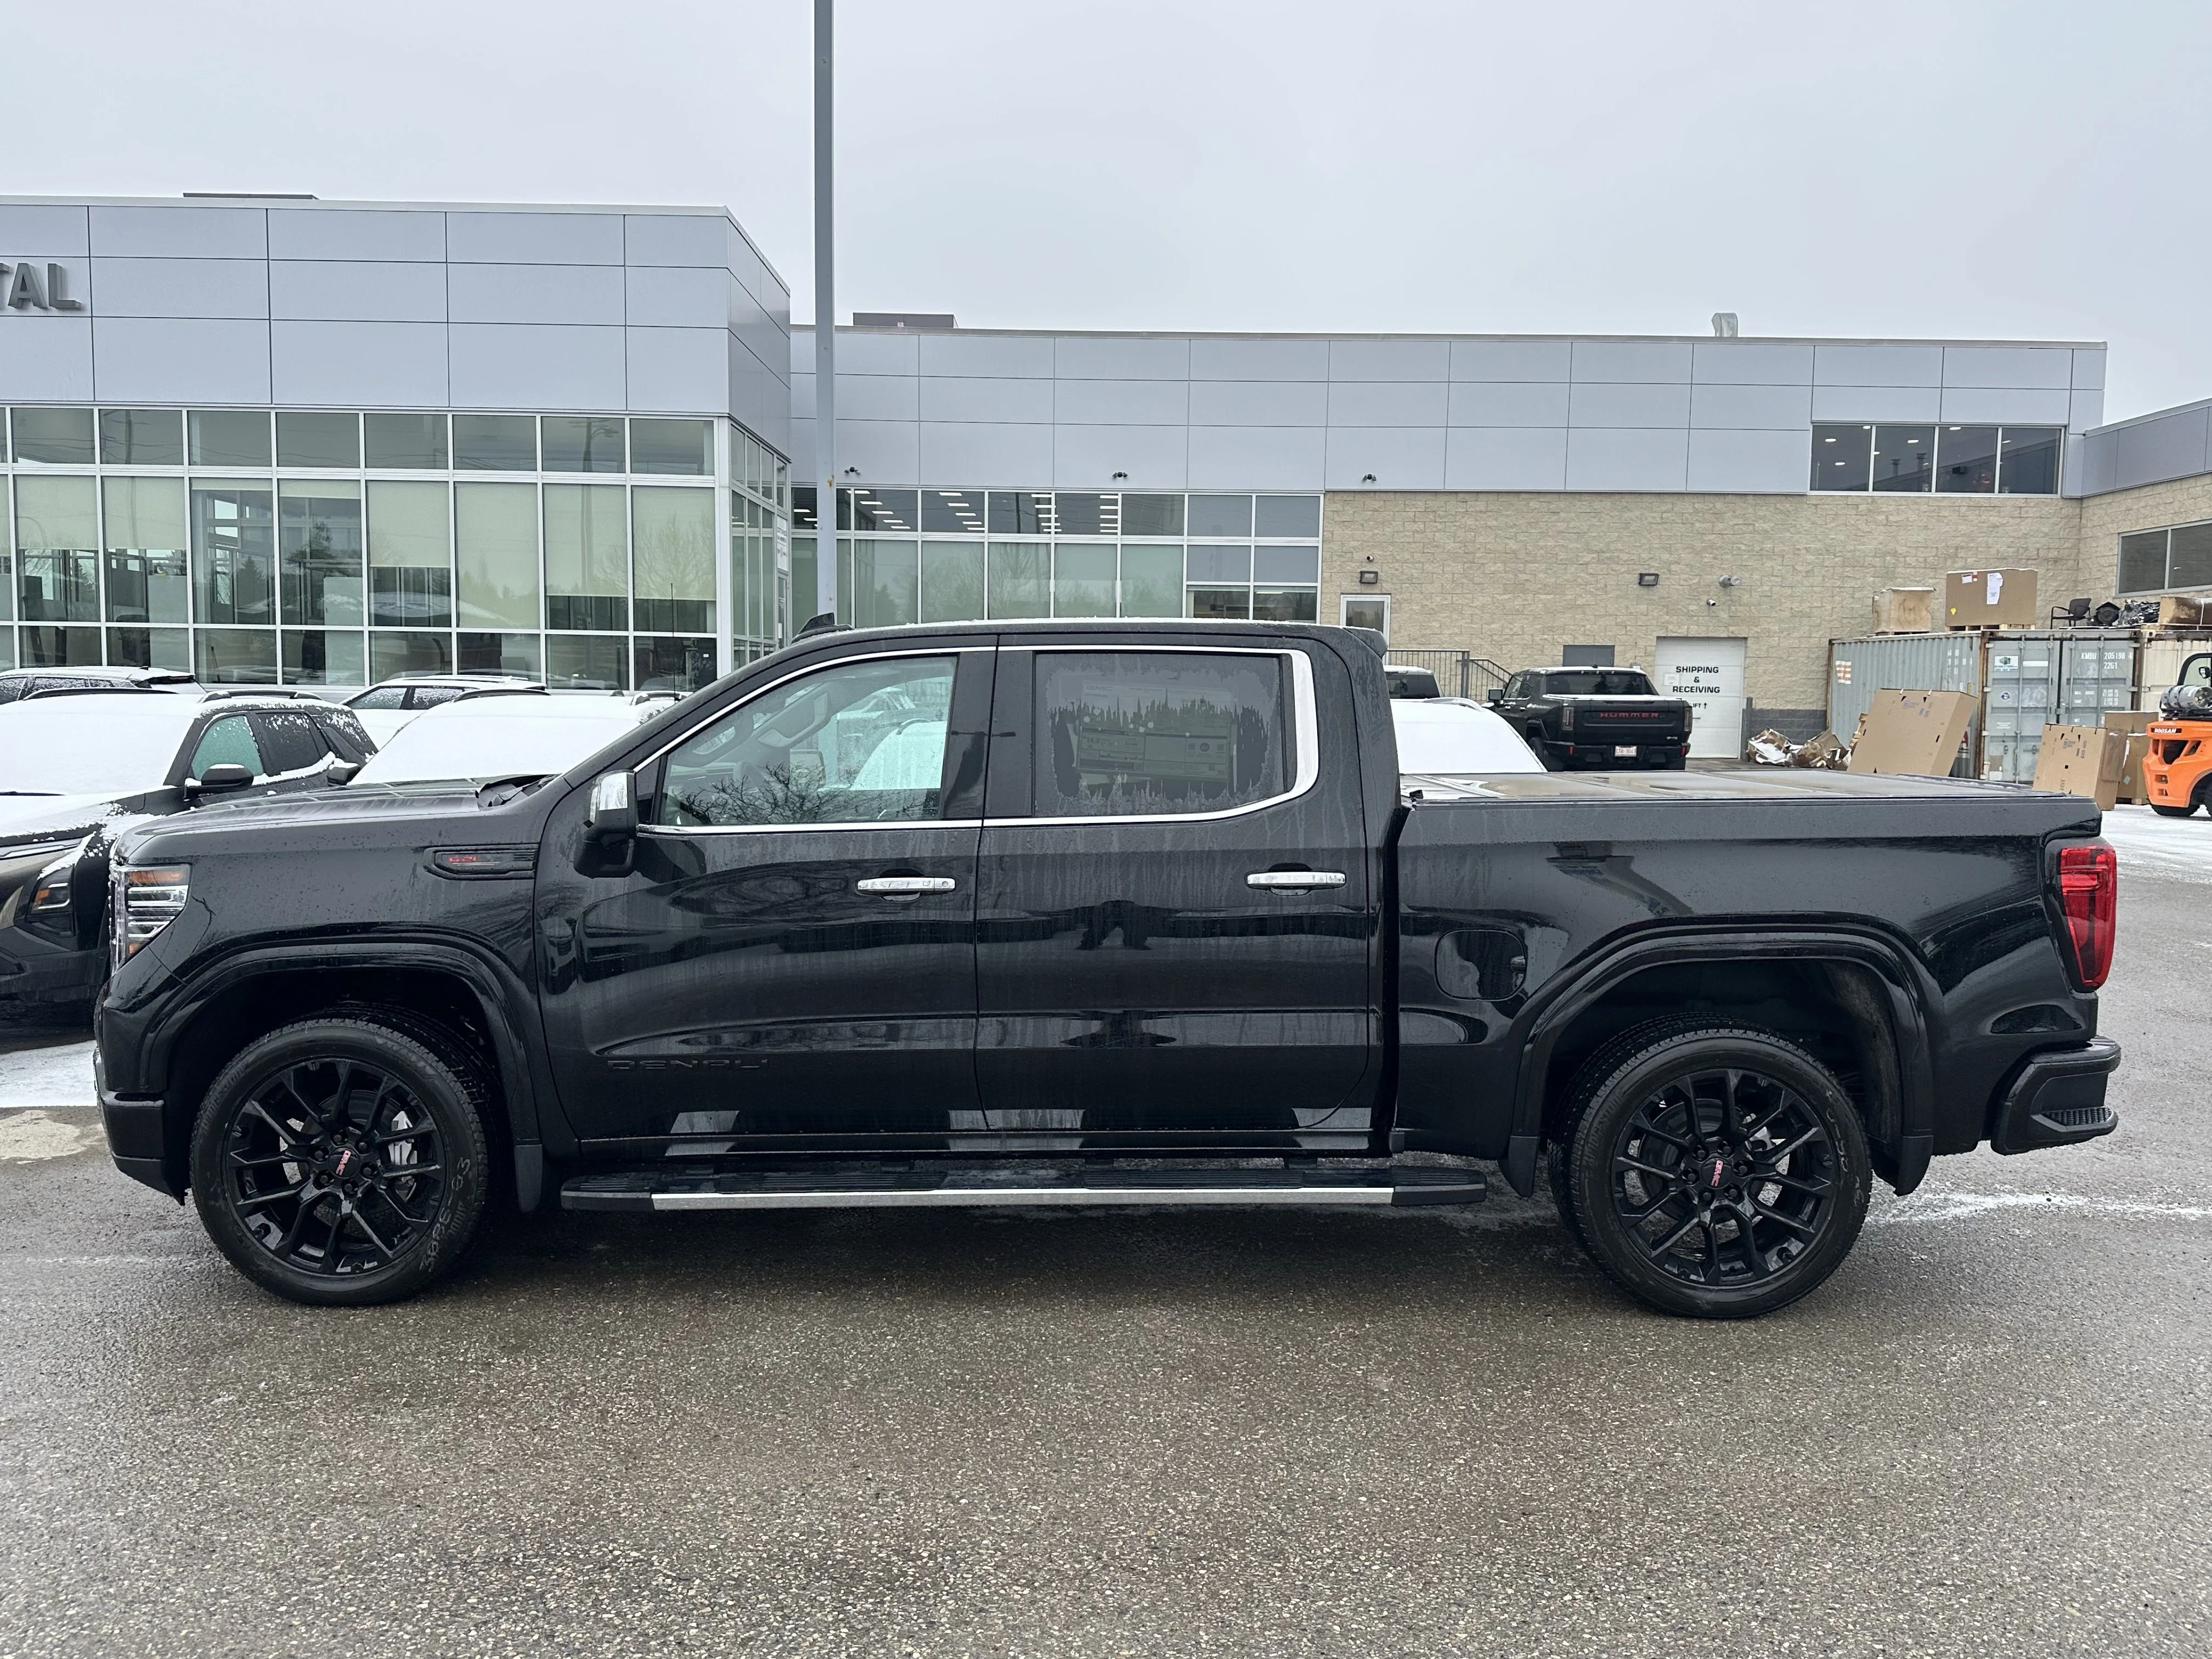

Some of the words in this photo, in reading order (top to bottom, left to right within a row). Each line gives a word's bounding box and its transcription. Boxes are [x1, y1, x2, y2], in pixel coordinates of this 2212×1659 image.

[607, 1059, 768, 1069] DENALI
[335, 1150, 351, 1176] GMC
[1711, 1160, 1724, 1187] GMC
